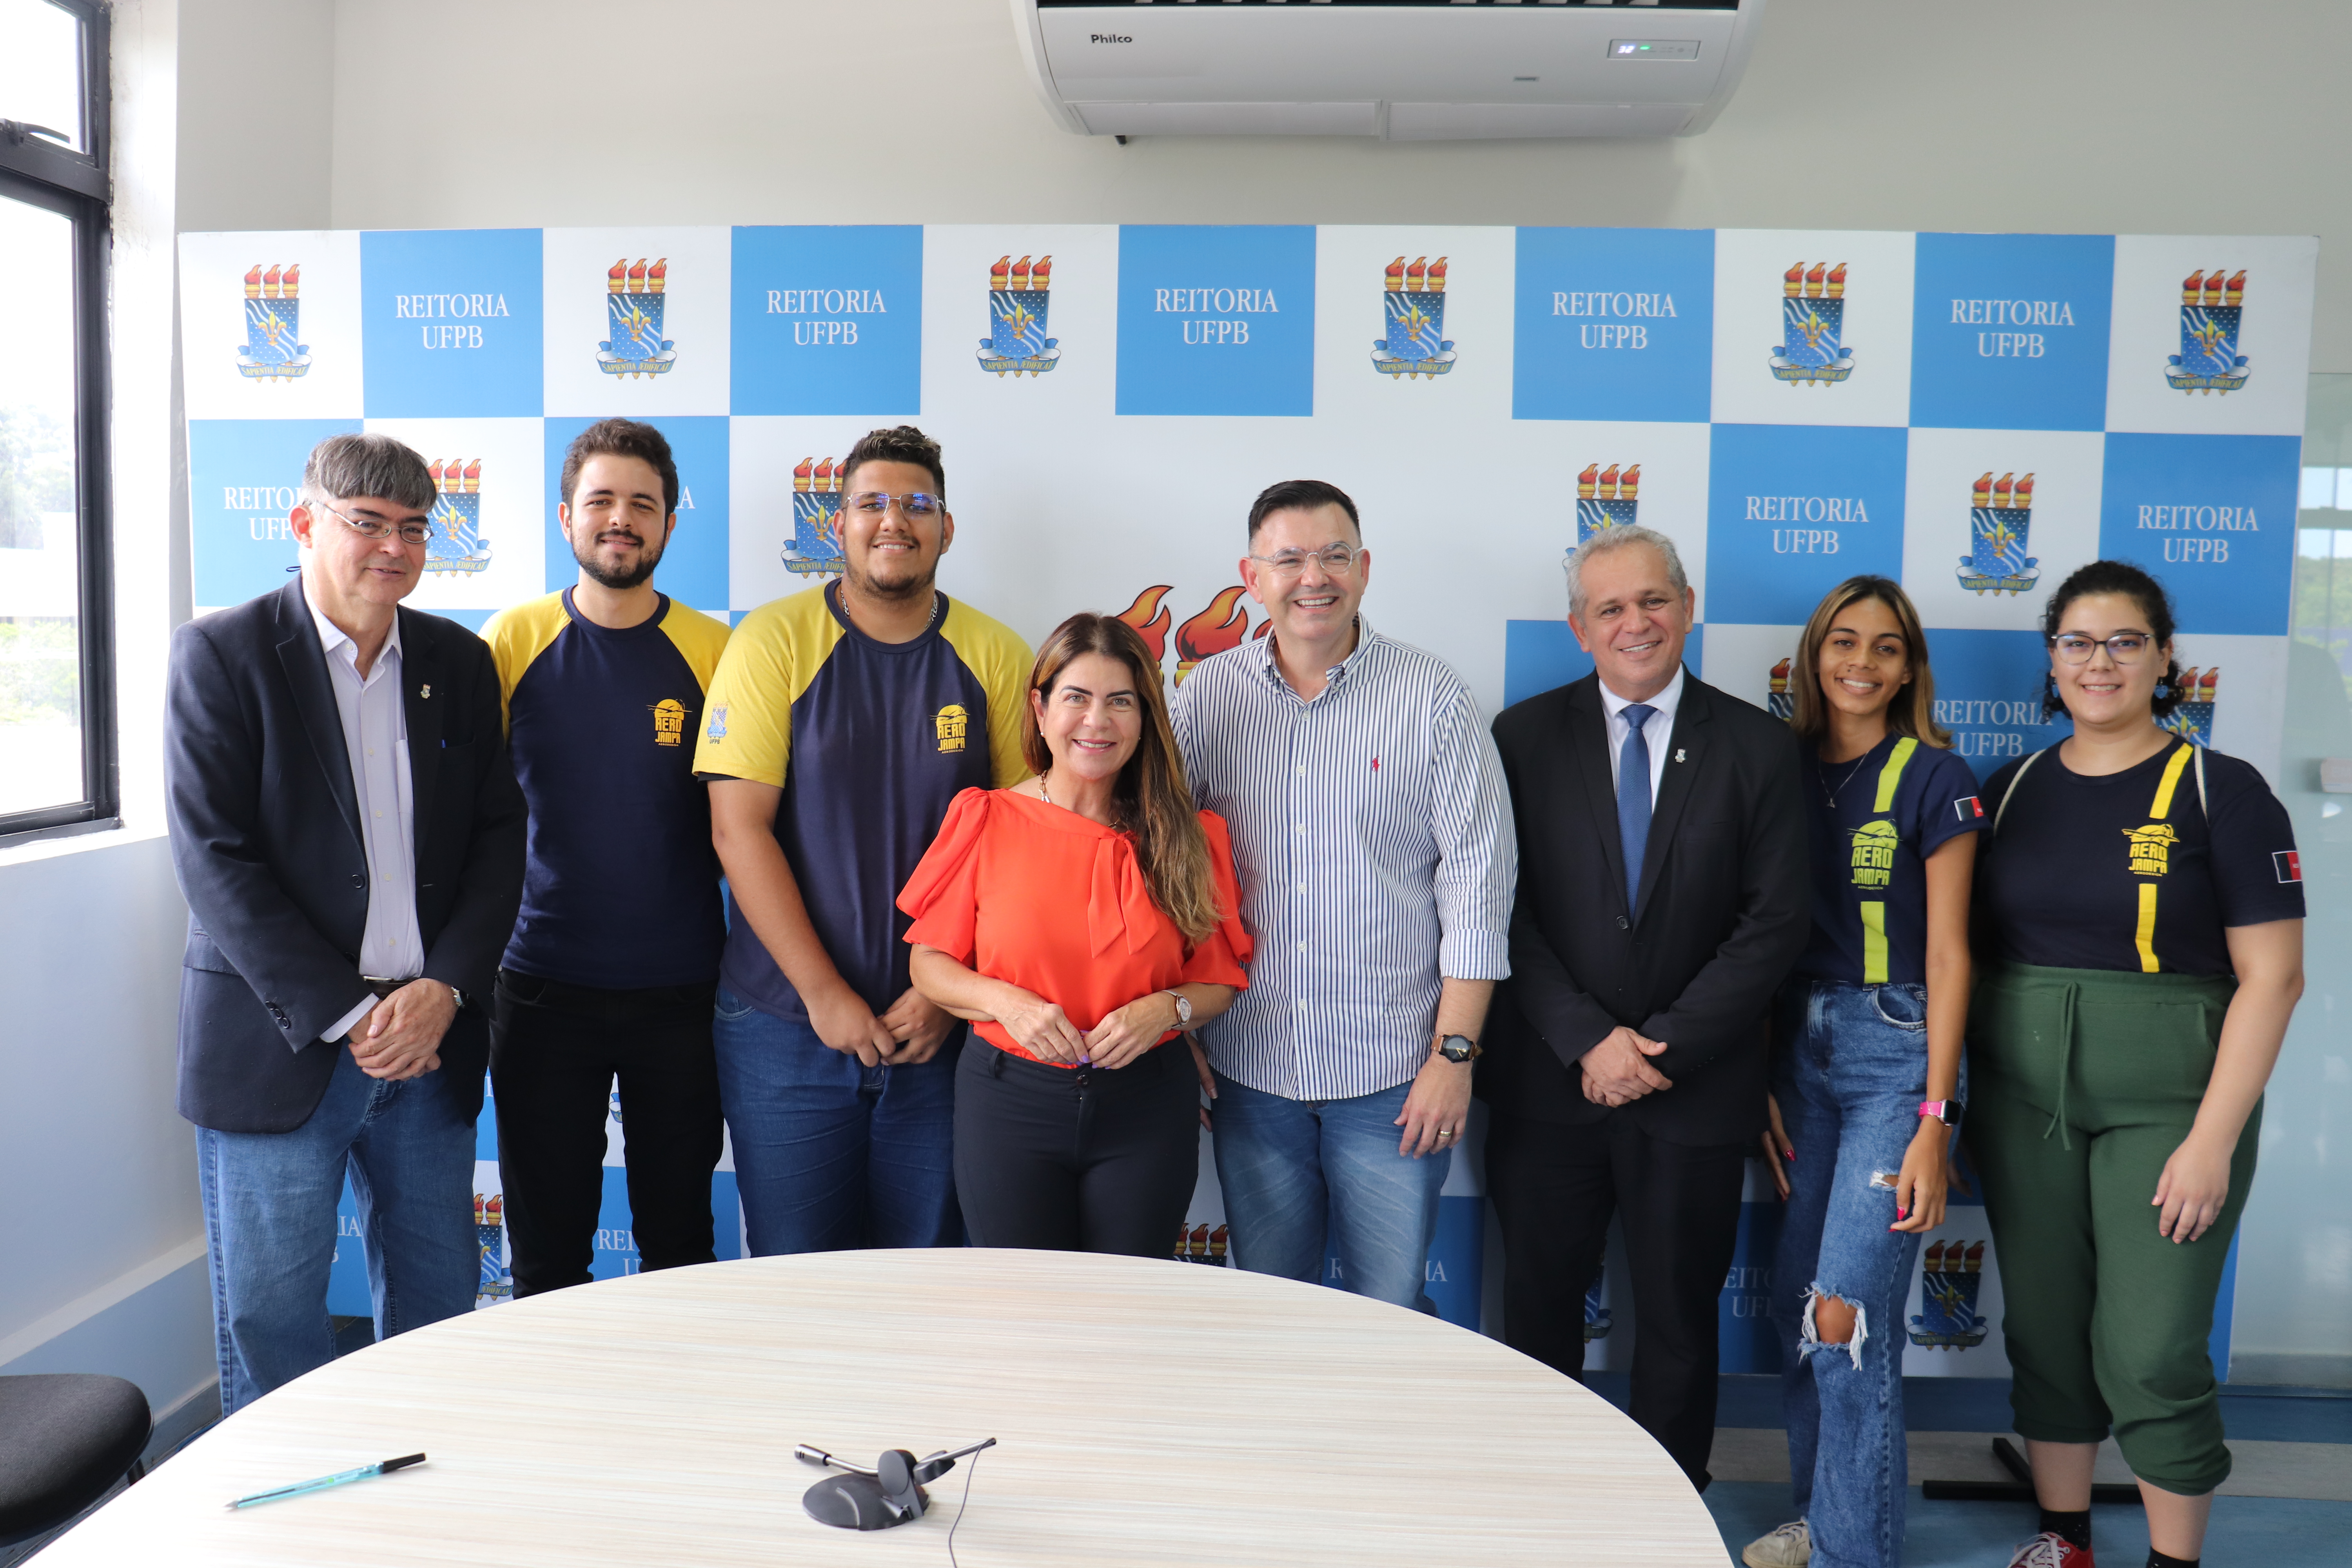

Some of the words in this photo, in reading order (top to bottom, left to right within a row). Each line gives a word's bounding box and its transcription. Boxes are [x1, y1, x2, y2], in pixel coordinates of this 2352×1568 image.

[1091, 34, 1132, 44] Philco
[395, 293, 510, 318] REITORIA
[766, 289, 887, 314] REITORIA
[1154, 288, 1279, 313] REITORIA
[1552, 292, 1677, 317] REITORIA
[1950, 299, 2075, 326] REITORIA
[421, 325, 483, 349] UFPB
[793, 321, 858, 345] UFPB
[1181, 321, 1249, 345] UFPB
[1580, 325, 1648, 349] UFPB
[1978, 333, 2045, 358] UFPB
[241, 367, 274, 376] SAPIENTIA
[602, 363, 636, 372] SAPIENTIA
[982, 361, 1018, 370] SAPIENTIA
[1376, 363, 1413, 372] SAPIENTIA
[223, 486, 301, 510] REITO
[1744, 496, 1869, 523] REITORIA
[249, 518, 292, 540] UFP
[2137, 505, 2259, 531] REITORIA
[1772, 529, 1839, 554] UFPB
[2164, 538, 2229, 563] UFPB
[787, 562, 822, 571] SAPIENTIA
[655, 718, 682, 732] AERO
[937, 723, 965, 739] AERO
[655, 731, 681, 744] JAMPA
[938, 737, 965, 751] JAMPA
[1958, 732, 2023, 757] UFPB
[1851, 846, 1893, 869] AERO
[2129, 843, 2167, 861] AERO
[1851, 868, 1890, 885] JAMPA
[2128, 858, 2167, 874] JAMPA
